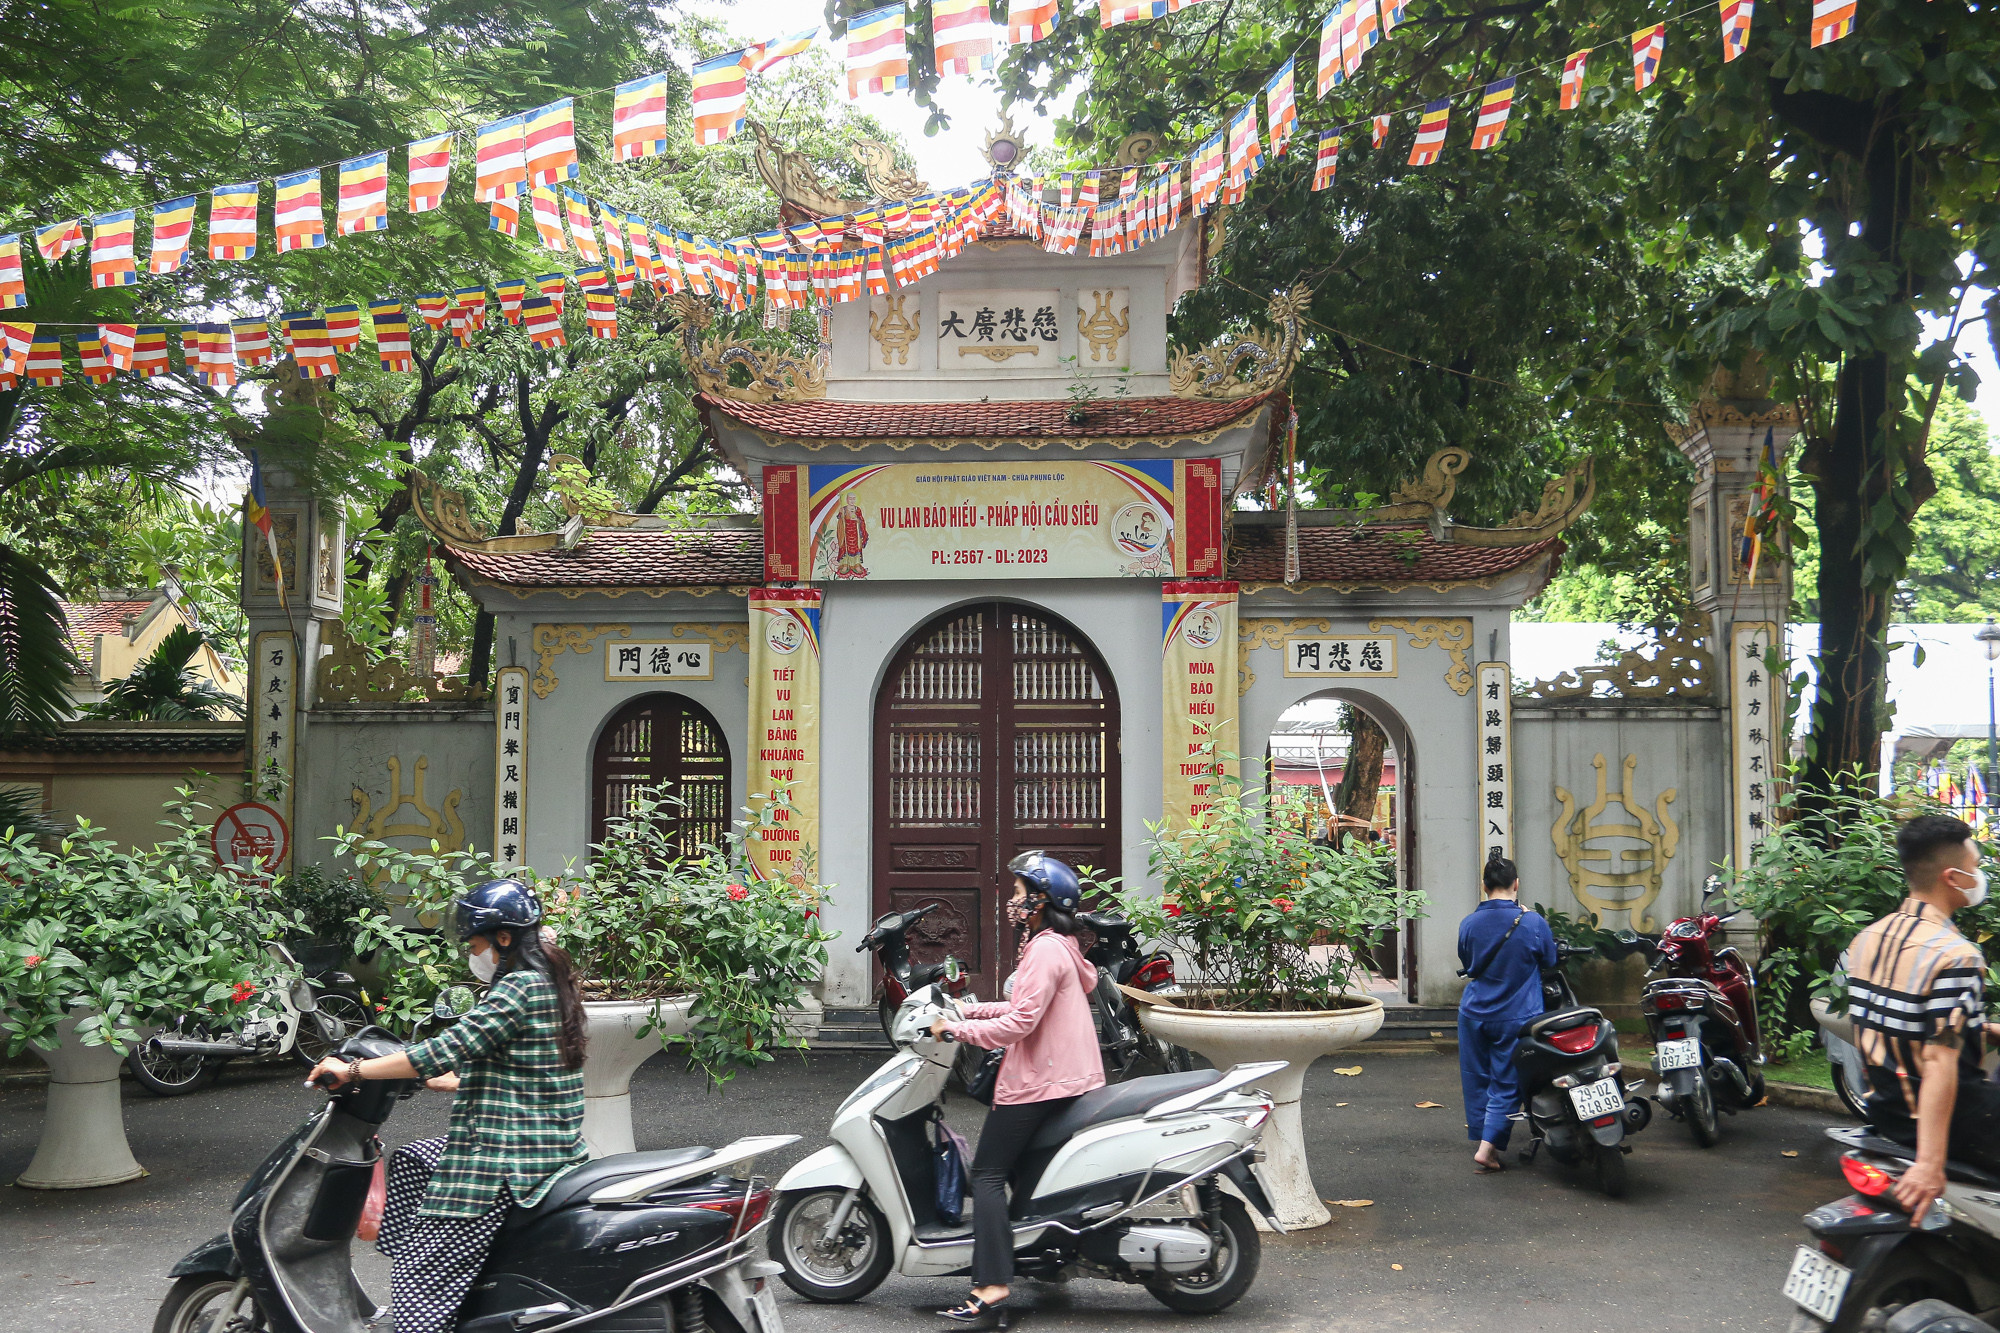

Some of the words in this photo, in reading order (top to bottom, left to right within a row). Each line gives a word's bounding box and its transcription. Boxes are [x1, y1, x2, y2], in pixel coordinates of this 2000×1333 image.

[915, 474, 931, 483] GIÁO
[931, 475, 943, 483] HỘI
[943, 474, 961, 483] PHẬT
[961, 474, 976, 482] GIÁO
[977, 474, 991, 483] VIỆT
[1012, 473, 1028, 481] CHÙA
[1030, 473, 1051, 483] PHỤNG
[1053, 473, 1065, 482] LỘC
[880, 507, 895, 528] VU
[898, 507, 921, 528] LAN
[923, 502, 947, 528] BÁO
[950, 499, 977, 528] HIẾU
[987, 501, 1019, 527] PHÁP
[1022, 501, 1042, 531] HỘI
[1045, 498, 1068, 526] CẦU
[1071, 500, 1098, 526] SIÊU
[931, 550, 951, 564] PL:
[954, 550, 984, 564] 2567
[995, 549, 1014, 564] DL:
[1017, 549, 1048, 563] 2023
[773, 666, 795, 681] TIẾT
[1189, 660, 1215, 674] MÙA
[1190, 680, 1213, 694] BÁO
[776, 689, 791, 701] VU
[1189, 699, 1215, 715] HIẾU
[772, 709, 793, 721] LAN
[767, 727, 797, 741] BÂNG
[760, 747, 804, 761] KHUÂNG
[770, 767, 793, 781] NHỚ
[770, 789, 792, 801] CA
[773, 809, 789, 821] ƠN
[762, 827, 800, 841] DƯỠNG
[770, 849, 792, 864] DỤC
[1661, 1052, 1697, 1068] 097.35
[1577, 1082, 1612, 1102] 29-D2
[1579, 1095, 1620, 1117] 348.99
